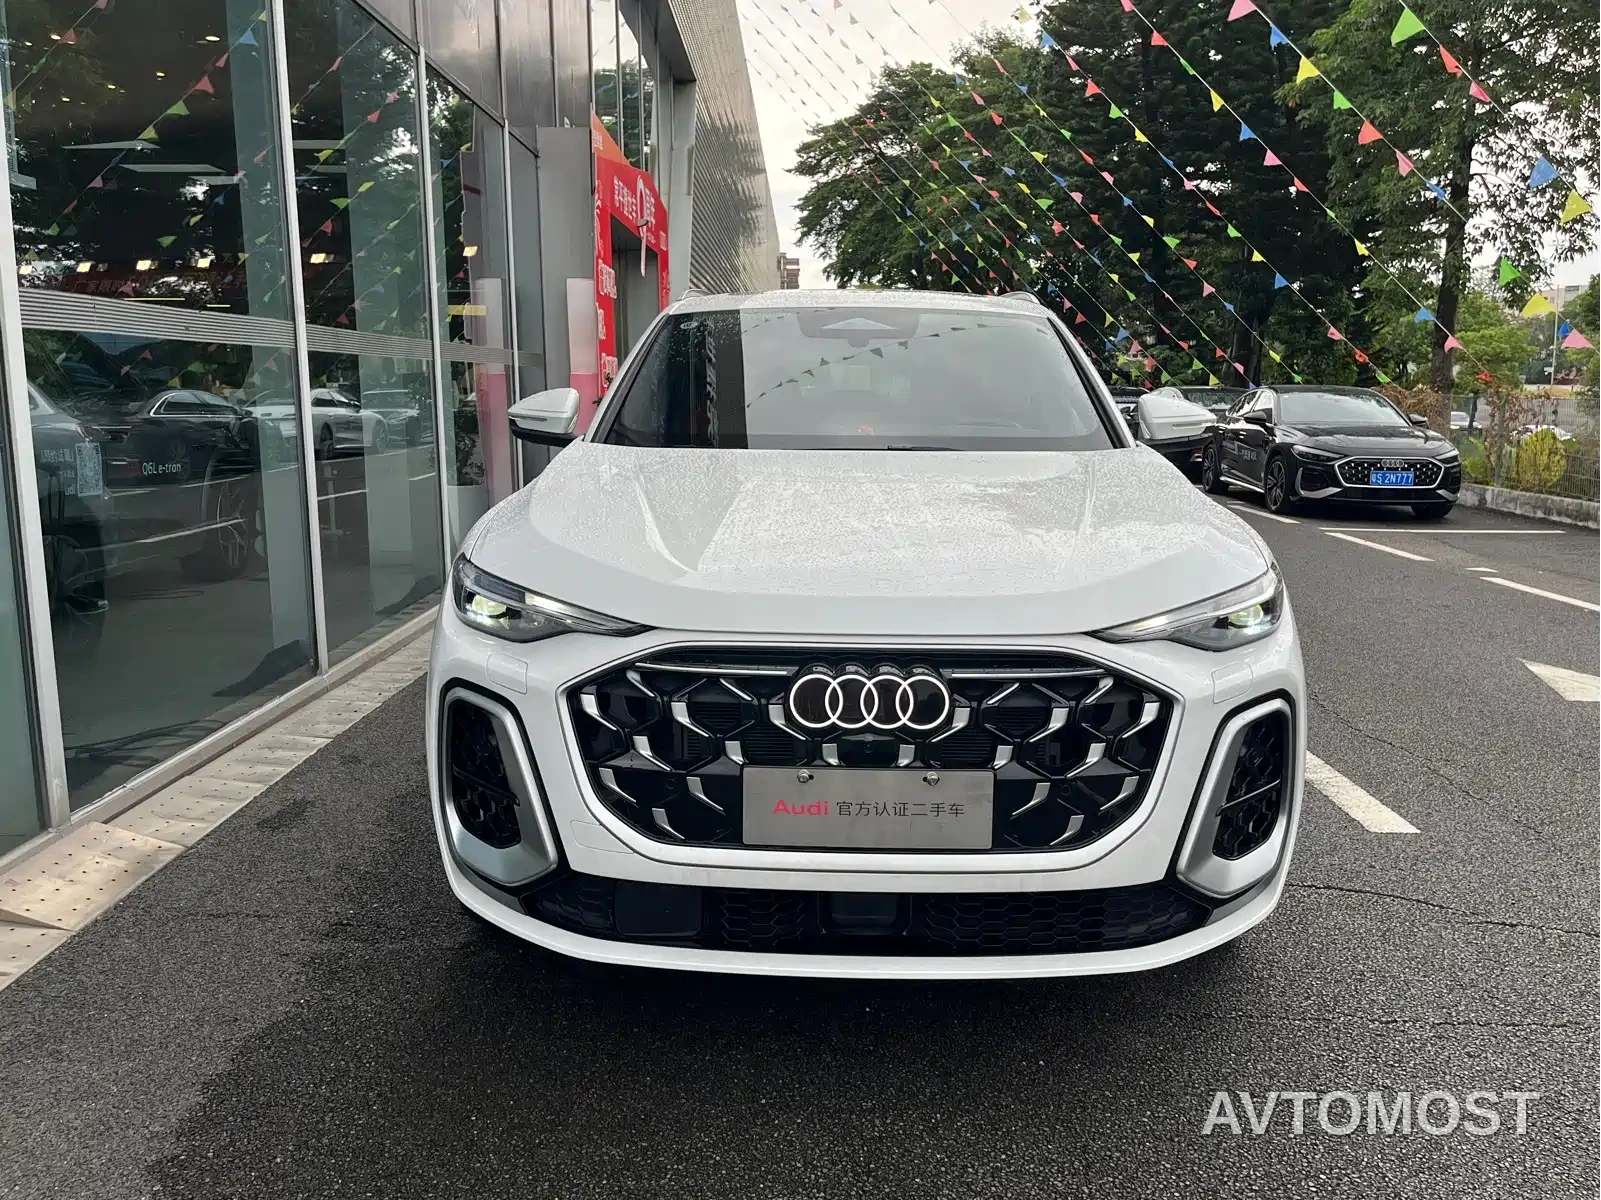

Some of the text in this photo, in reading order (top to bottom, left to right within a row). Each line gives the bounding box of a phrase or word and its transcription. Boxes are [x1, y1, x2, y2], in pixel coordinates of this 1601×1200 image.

[142, 462, 181, 476] Q6L e-tron
[772, 800, 829, 816] Audi
[836, 801, 1541, 1136] 官方认证二手车 AVTOMOST
